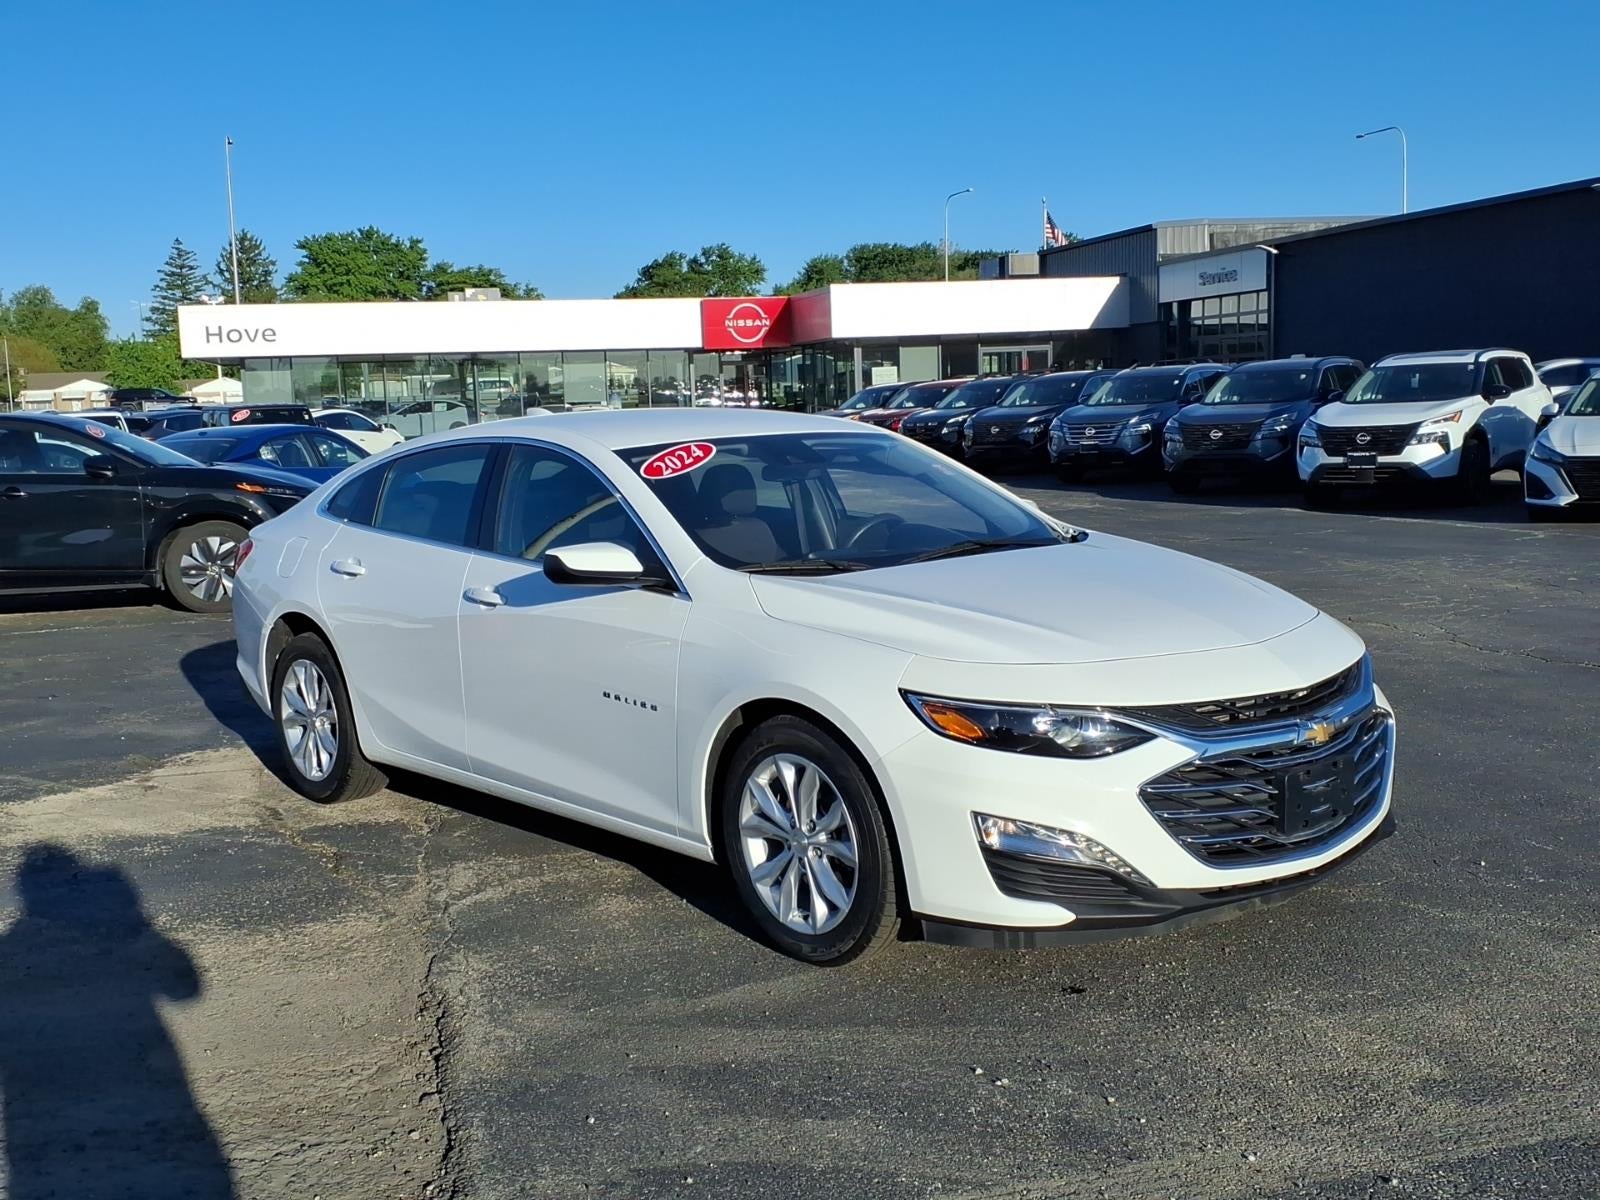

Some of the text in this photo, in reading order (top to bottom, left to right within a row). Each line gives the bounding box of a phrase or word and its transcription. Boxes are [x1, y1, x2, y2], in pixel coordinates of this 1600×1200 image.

[725, 319, 770, 327] NISSAN
[205, 325, 276, 344] Hove
[653, 444, 704, 476] 2024
